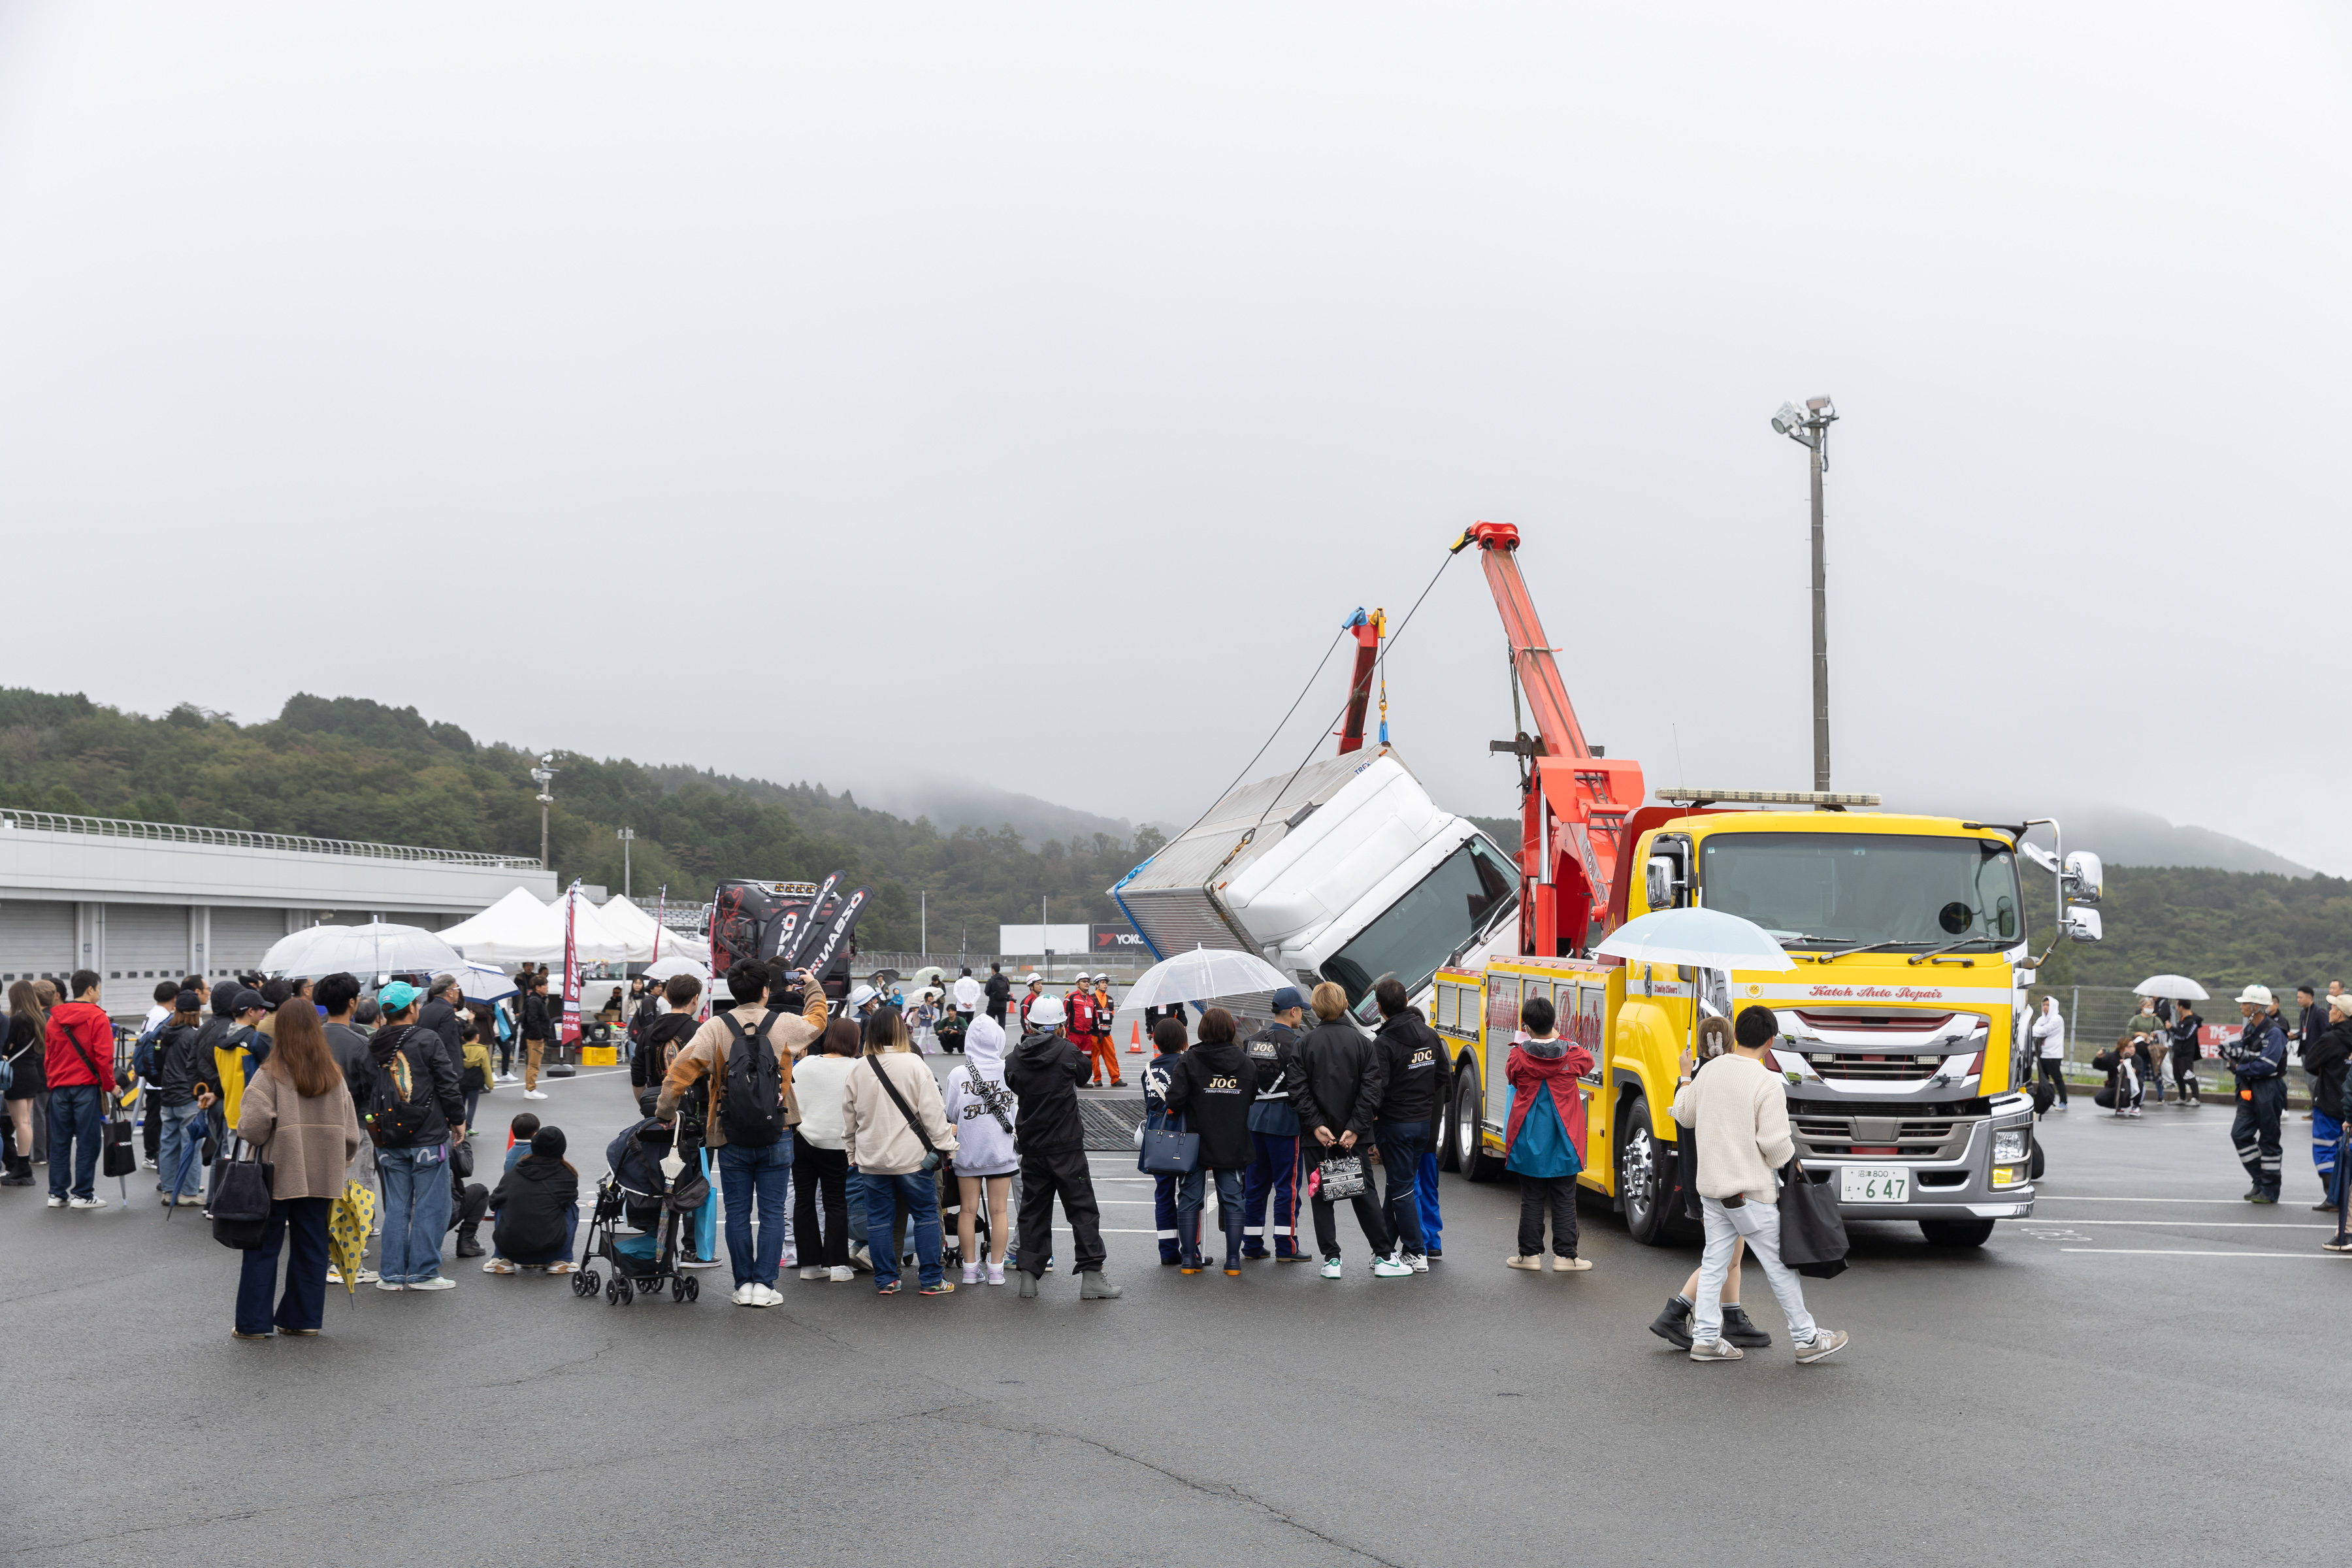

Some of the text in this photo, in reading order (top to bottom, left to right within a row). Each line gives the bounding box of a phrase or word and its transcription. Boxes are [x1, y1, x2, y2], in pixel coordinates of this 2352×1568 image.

[1809, 986, 1942, 1001] Katoh Auto Repair
[1253, 1043, 1274, 1053] JOC
[1412, 1049, 1432, 1064] JOC
[1159, 1068, 1171, 1085] Service
[1209, 1078, 1237, 1088] JOC
